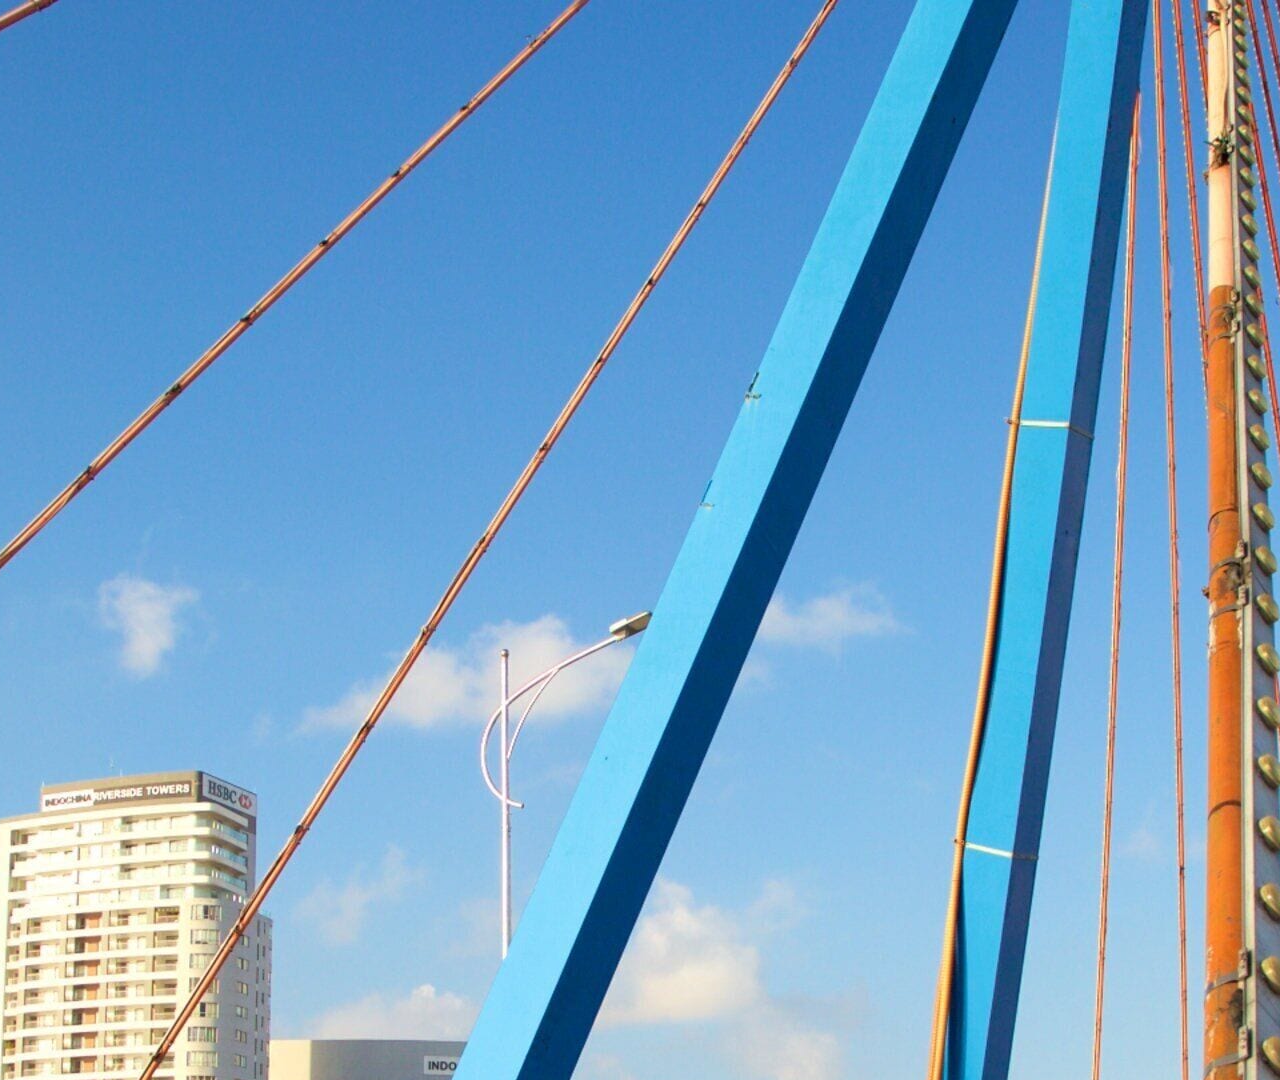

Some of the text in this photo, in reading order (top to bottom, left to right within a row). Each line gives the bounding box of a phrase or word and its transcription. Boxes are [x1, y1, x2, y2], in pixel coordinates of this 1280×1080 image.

[45, 783, 190, 807] INDOCHINA RIVERSIDE TOWERS
[207, 780, 237, 804] HSBC
